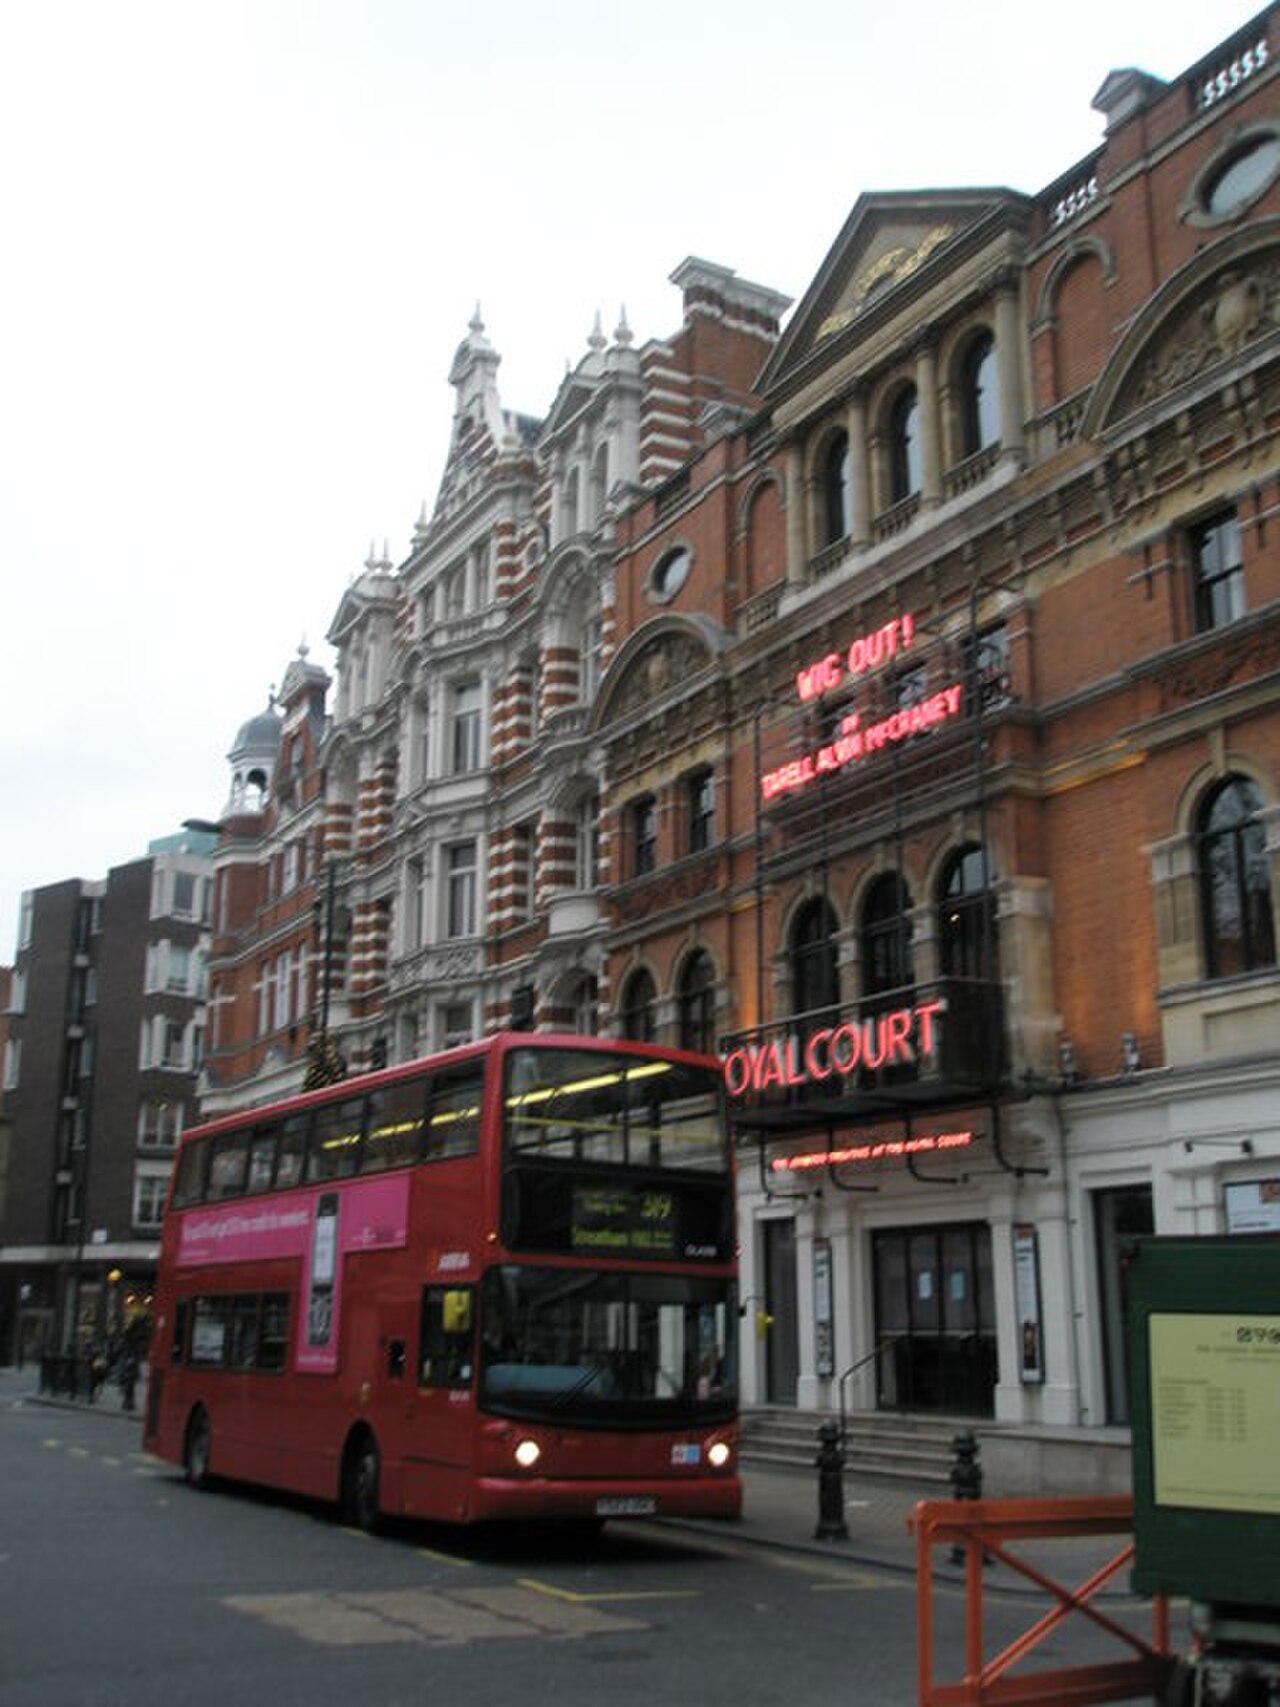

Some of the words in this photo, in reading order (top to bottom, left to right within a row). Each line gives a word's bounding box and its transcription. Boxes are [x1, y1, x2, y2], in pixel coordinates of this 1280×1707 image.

[796, 652, 843, 700] WIG
[847, 613, 914, 673] OUT!
[723, 1036, 806, 1096] OYAL
[805, 998, 948, 1080] COURT
